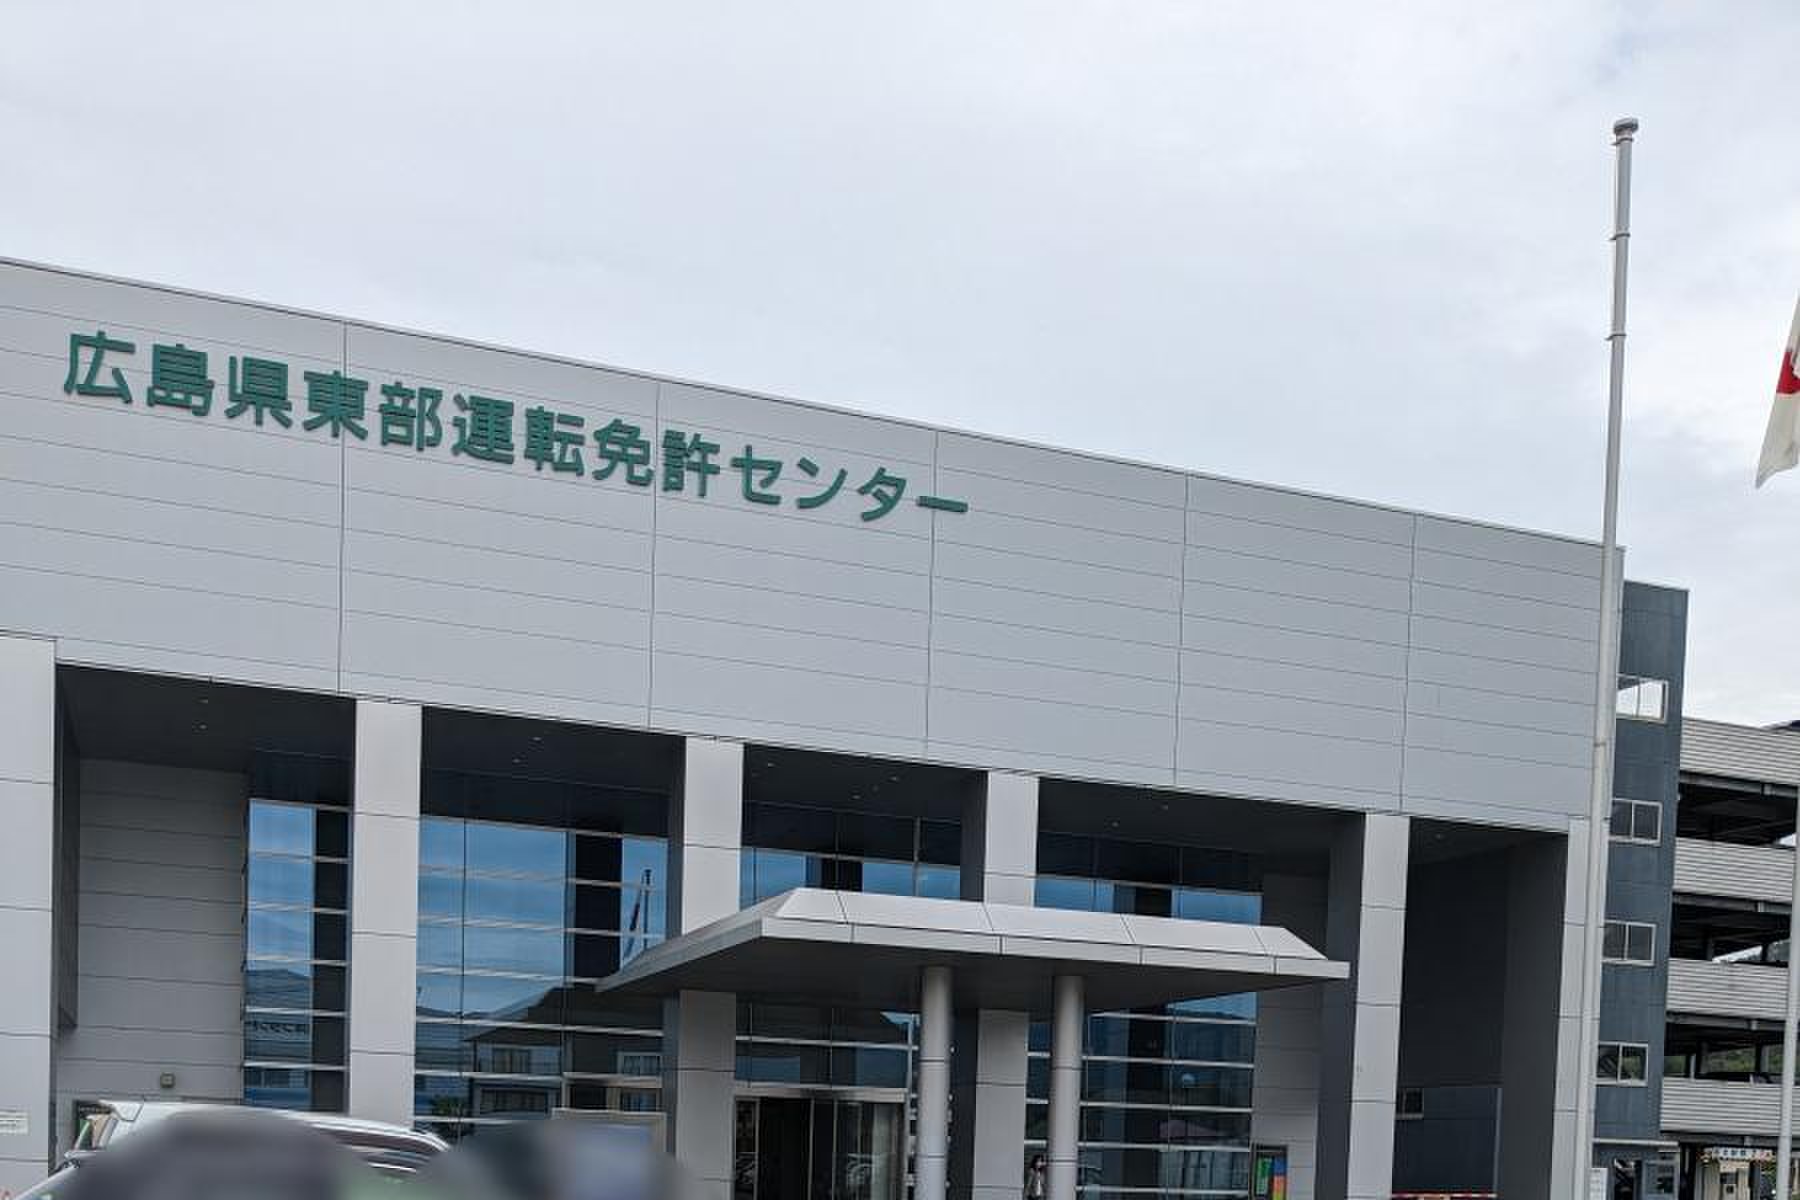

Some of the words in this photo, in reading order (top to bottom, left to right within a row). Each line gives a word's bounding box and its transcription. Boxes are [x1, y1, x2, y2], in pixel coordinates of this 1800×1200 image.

[63, 330, 969, 521] 広島県東部運転免許センター
